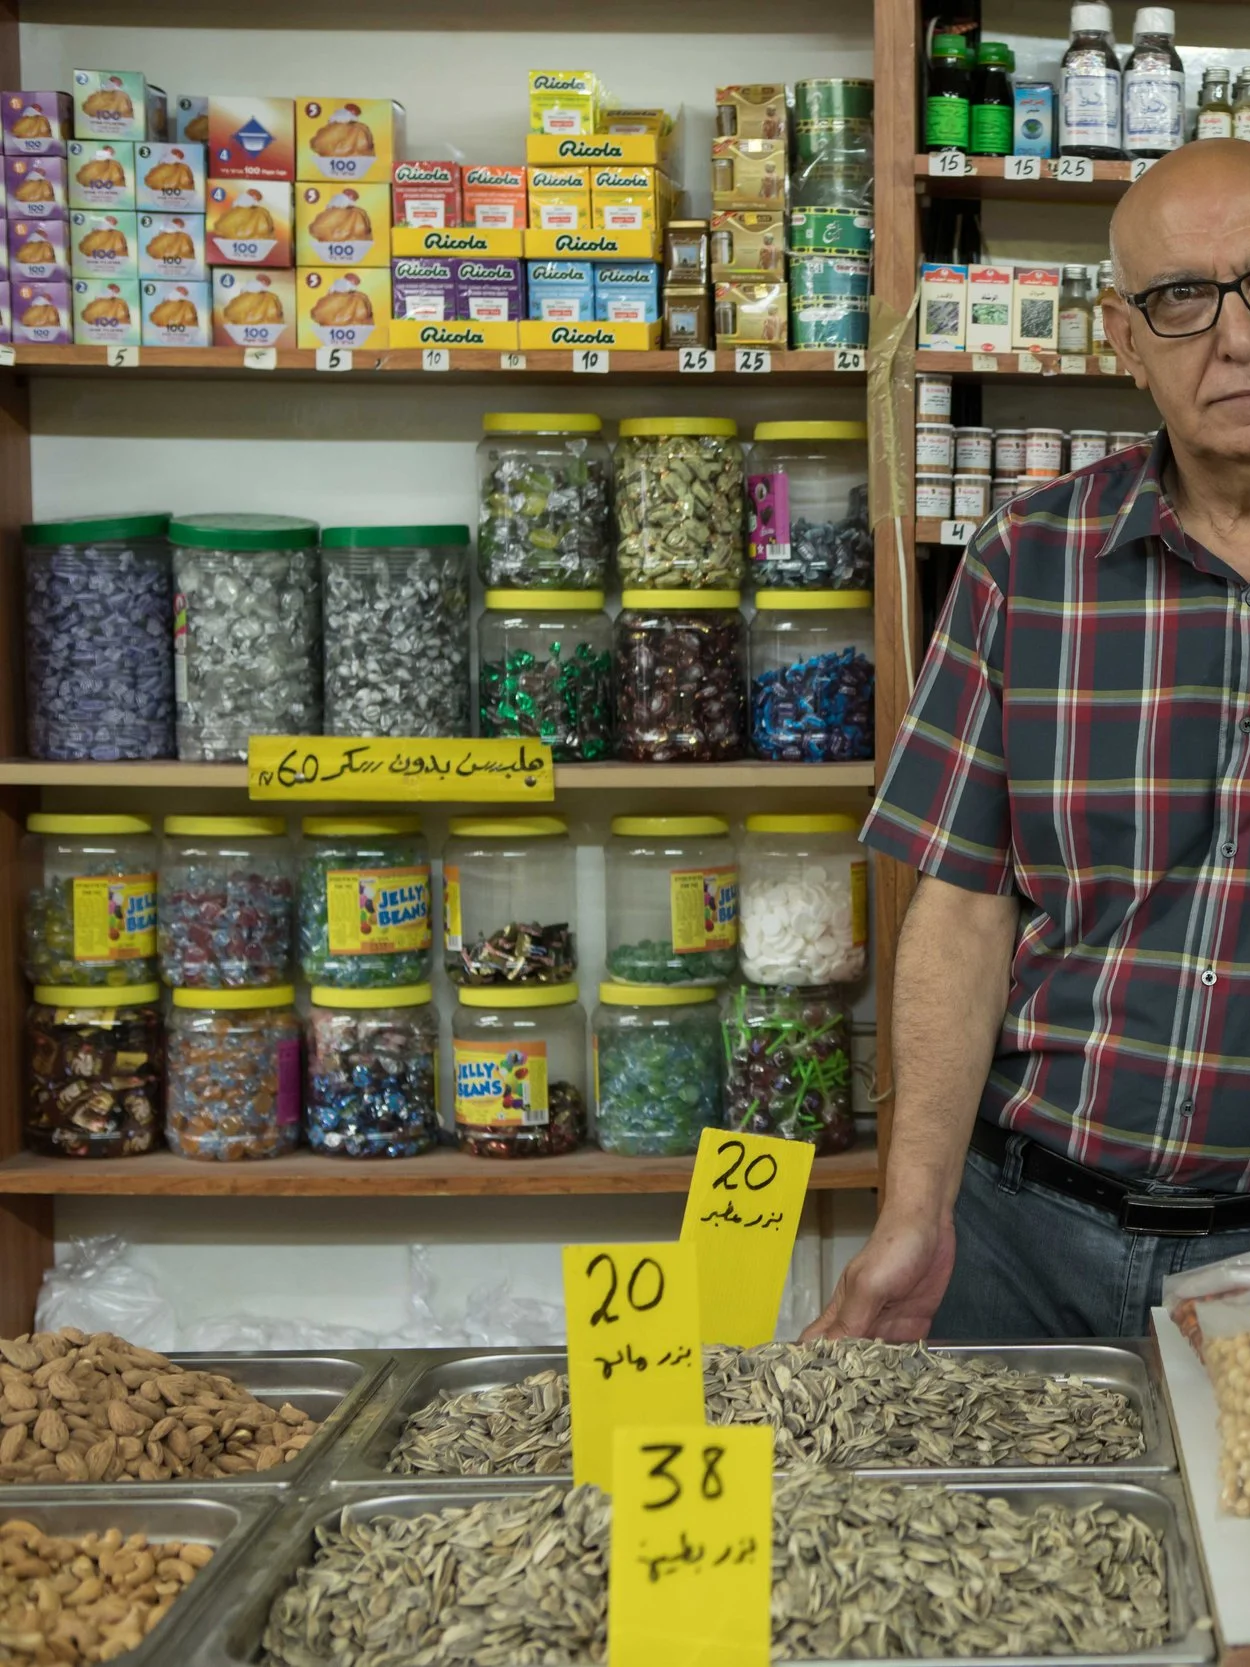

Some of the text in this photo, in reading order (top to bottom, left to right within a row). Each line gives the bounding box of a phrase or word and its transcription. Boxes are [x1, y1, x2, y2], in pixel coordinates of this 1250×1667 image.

[534, 75, 586, 90] Ricola
[25, 140, 41, 149] 100
[559, 140, 622, 157] Ricola
[244, 166, 261, 175] 100
[330, 159, 356, 171] 100
[939, 154, 960, 172] 15
[1014, 159, 1034, 175] 15
[1061, 159, 1086, 177] 25
[397, 166, 449, 181] Ricola
[467, 170, 519, 185] Ricola
[533, 172, 583, 187] Ricola
[596, 172, 648, 187] Ricola
[161, 187, 181, 196] 100
[28, 204, 45, 212] 100
[232, 242, 258, 253] 100
[424, 233, 487, 249] Ricola
[556, 235, 618, 251] Ricola
[92, 249, 116, 260] 100
[328, 245, 354, 256] 100
[162, 256, 182, 265] 100
[397, 263, 449, 278] Ricola
[459, 264, 512, 279] Ricola
[533, 266, 585, 280] Ricola
[600, 269, 650, 283] Ricola
[95, 317, 119, 327] 100
[166, 324, 185, 332] 100
[33, 329, 49, 337] 100
[244, 328, 268, 339] 100
[329, 329, 355, 340] 100
[421, 327, 484, 343] Ricola
[552, 327, 615, 344] Ricola
[329, 349, 341, 368] 5
[427, 350, 441, 366] 10
[507, 354, 519, 368] 10
[582, 351, 598, 370] 10
[683, 351, 708, 369] 25
[740, 352, 764, 371] 25
[838, 351, 860, 369] 20
[277, 750, 319, 787] 60
[320, 746, 385, 781] سكر
[388, 753, 451, 780] بدون
[379, 884, 424, 909] JELLY
[377, 901, 427, 927] BEANS
[712, 1140, 778, 1192] 20
[744, 1212, 784, 1231] بزر
[585, 1252, 665, 1328] 20
[657, 1346, 692, 1368] بزر
[639, 1443, 727, 1511] 38
[713, 1537, 757, 1567] بزر
